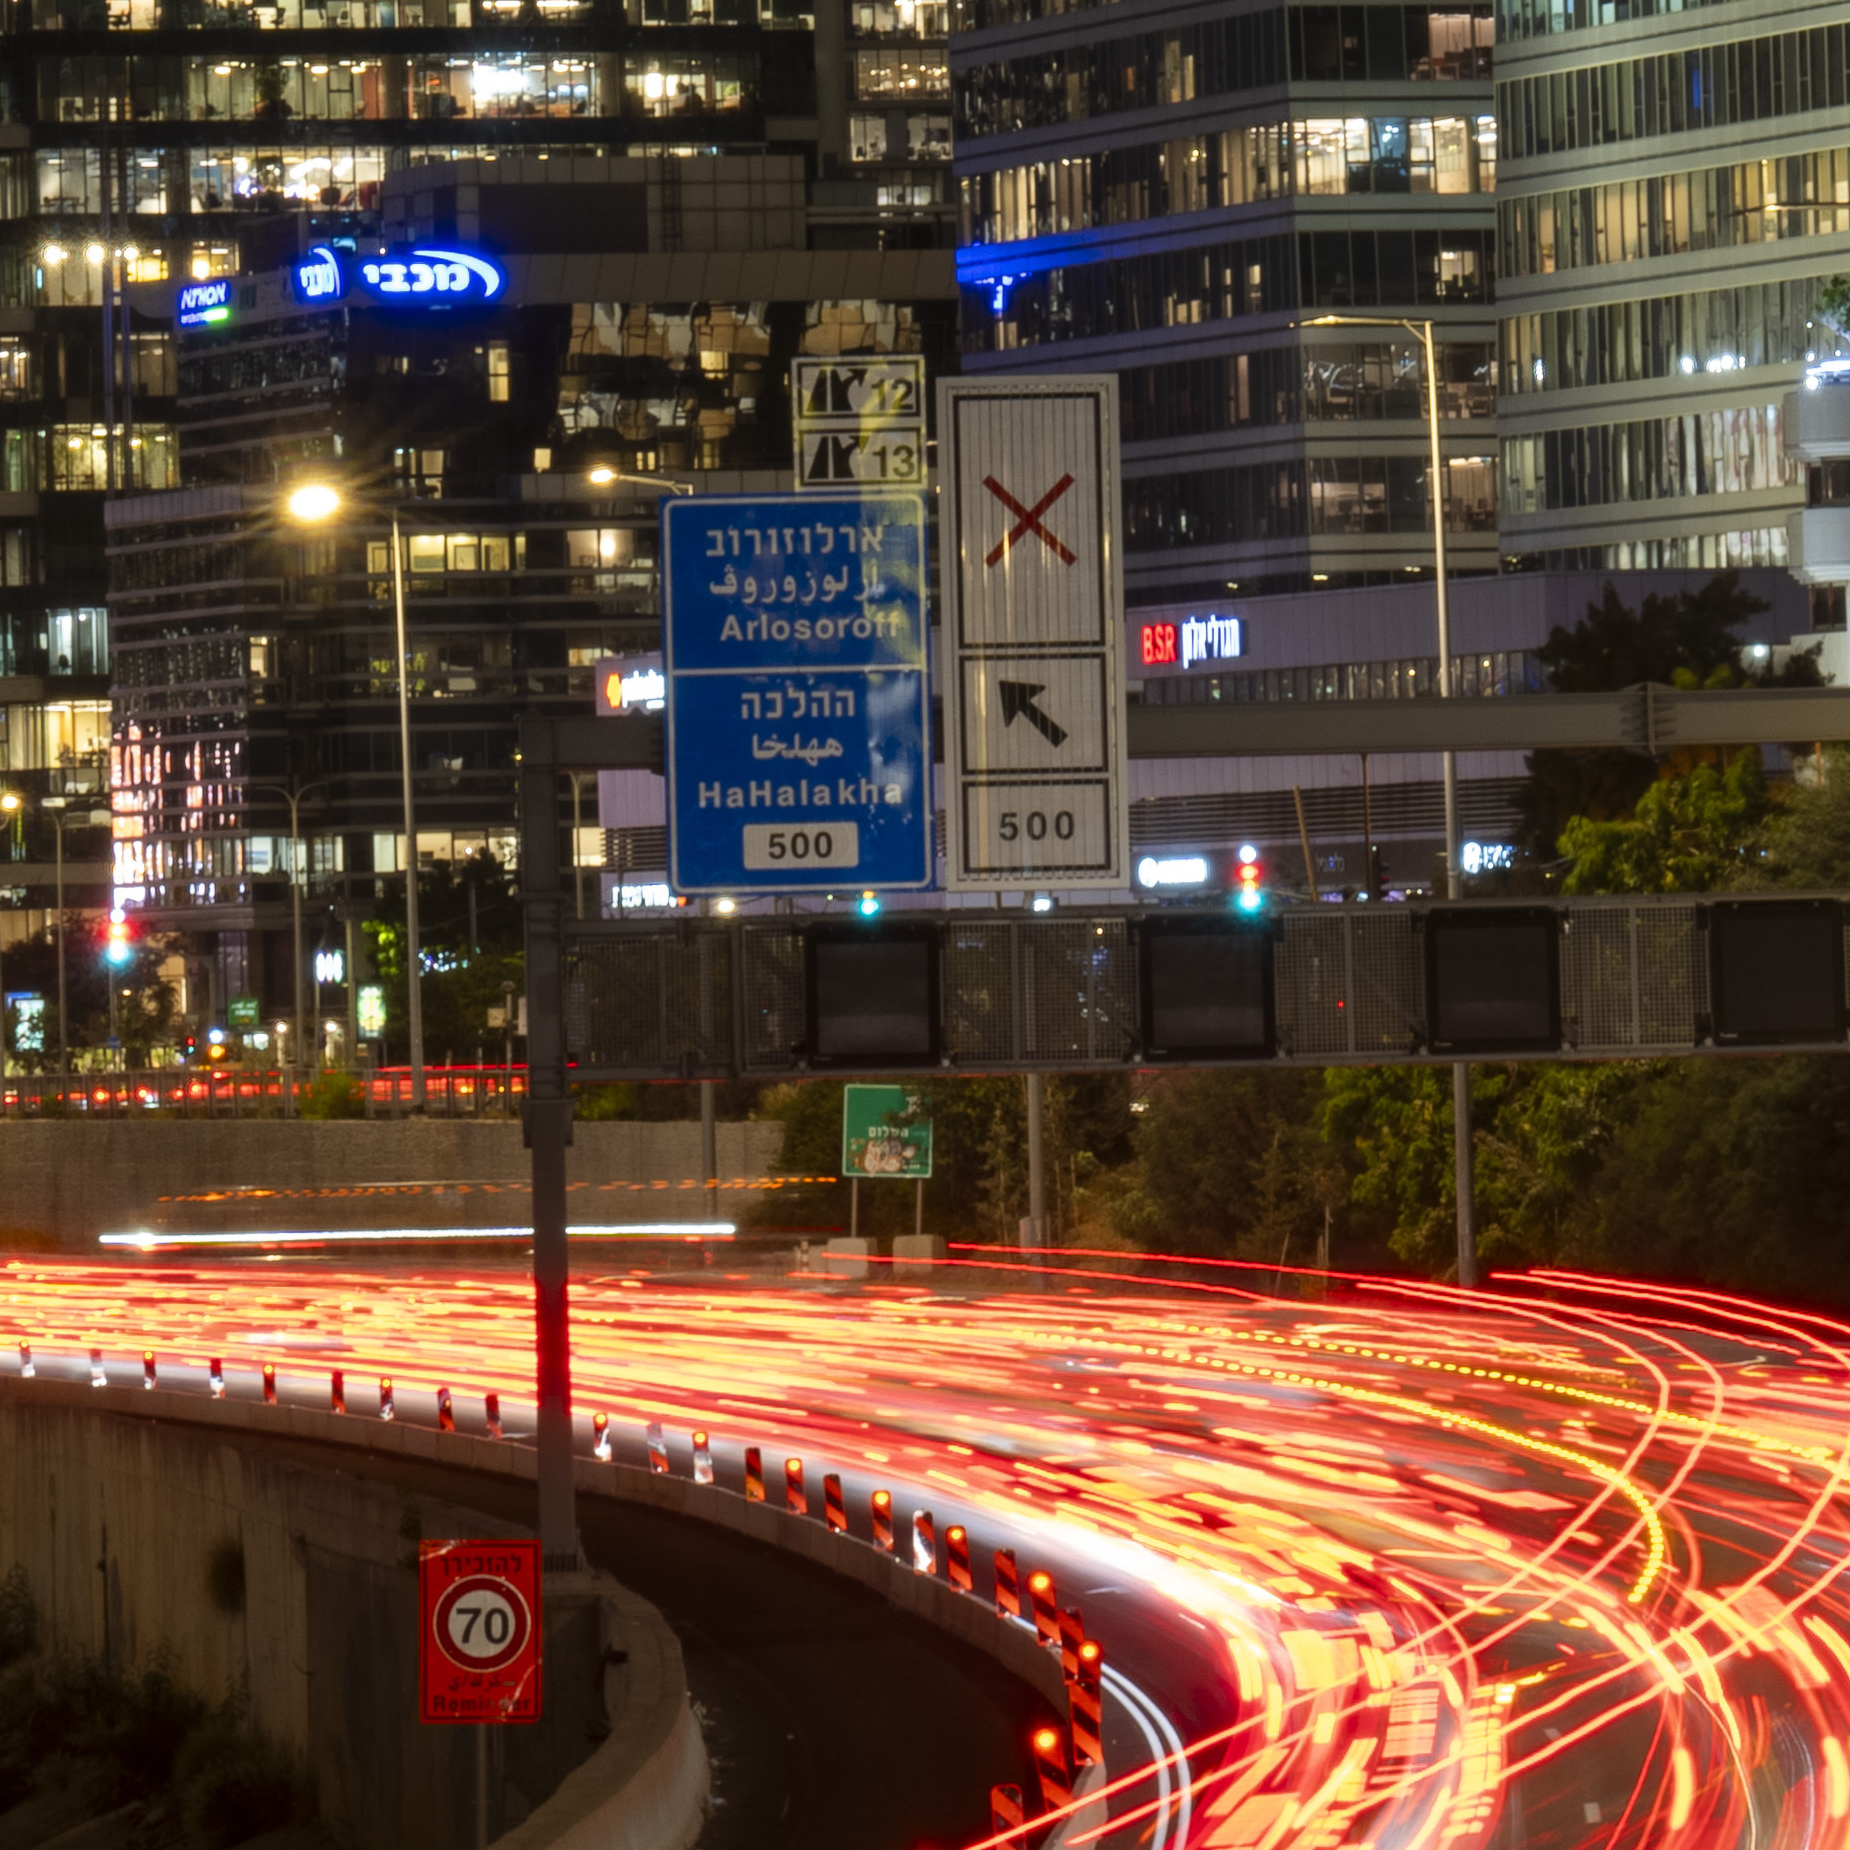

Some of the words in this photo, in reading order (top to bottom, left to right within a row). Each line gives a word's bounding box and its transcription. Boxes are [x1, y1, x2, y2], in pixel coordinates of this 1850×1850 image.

[363, 262, 470, 292] מכבי
[870, 380, 914, 411] 12
[871, 444, 916, 477] 13
[705, 522, 885, 558] ארלוזורוב
[719, 610, 902, 642] Arlosoroff
[740, 686, 856, 720] ההלכה
[698, 777, 903, 809] HaHalakha
[999, 811, 1075, 841] 500
[767, 831, 833, 860] 500
[439, 1553, 522, 1577] להזכירך
[455, 1607, 510, 1645] 70
